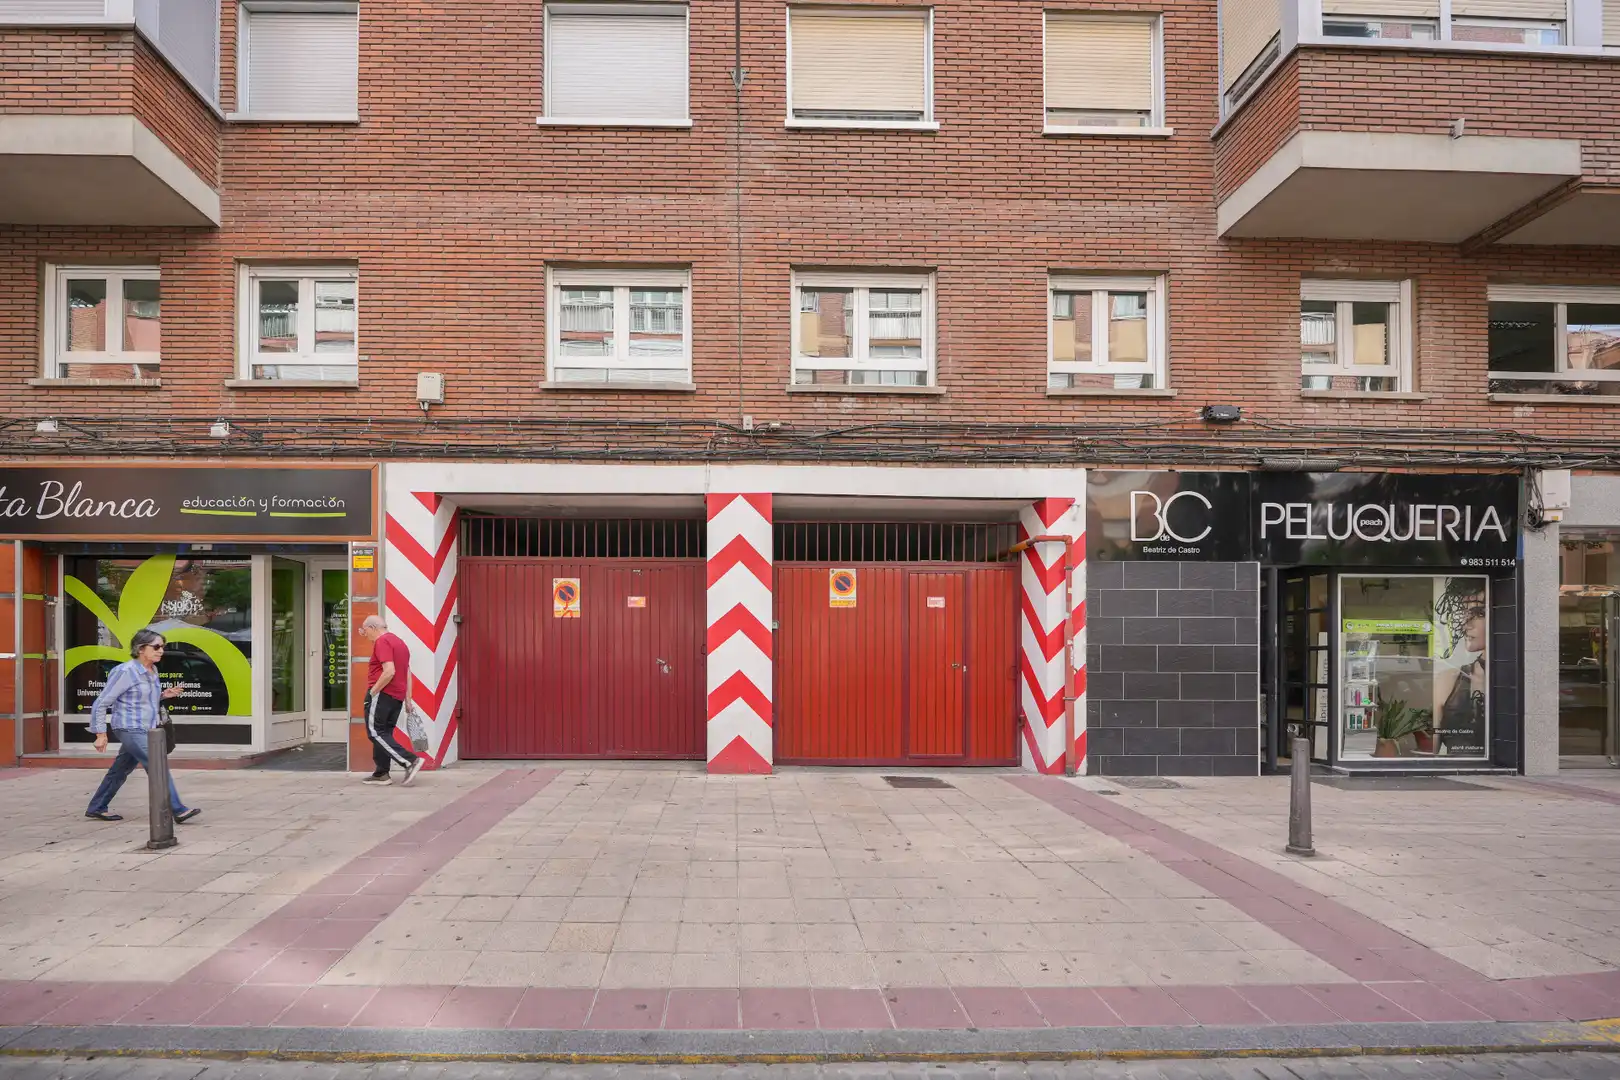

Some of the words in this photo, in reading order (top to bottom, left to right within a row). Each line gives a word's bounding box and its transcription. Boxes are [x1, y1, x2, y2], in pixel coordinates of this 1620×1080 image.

[36, 480, 161, 520] Blanca
[182, 495, 255, 508] educación
[259, 499, 268, 512] y
[271, 495, 345, 508] formación
[1260, 502, 1508, 543] PELUQUERIA
[1360, 518, 1383, 527] peach
[1160, 533, 1170, 542] de
[1142, 546, 1167, 554] Beatriz
[1167, 546, 1177, 554] de
[1178, 546, 1201, 554] Castro
[1468, 558, 1483, 566] 983
[1485, 558, 1499, 566] 511
[1500, 558, 1516, 566] 514
[88, 679, 107, 688] Prima
[176, 690, 213, 698] posiciones
